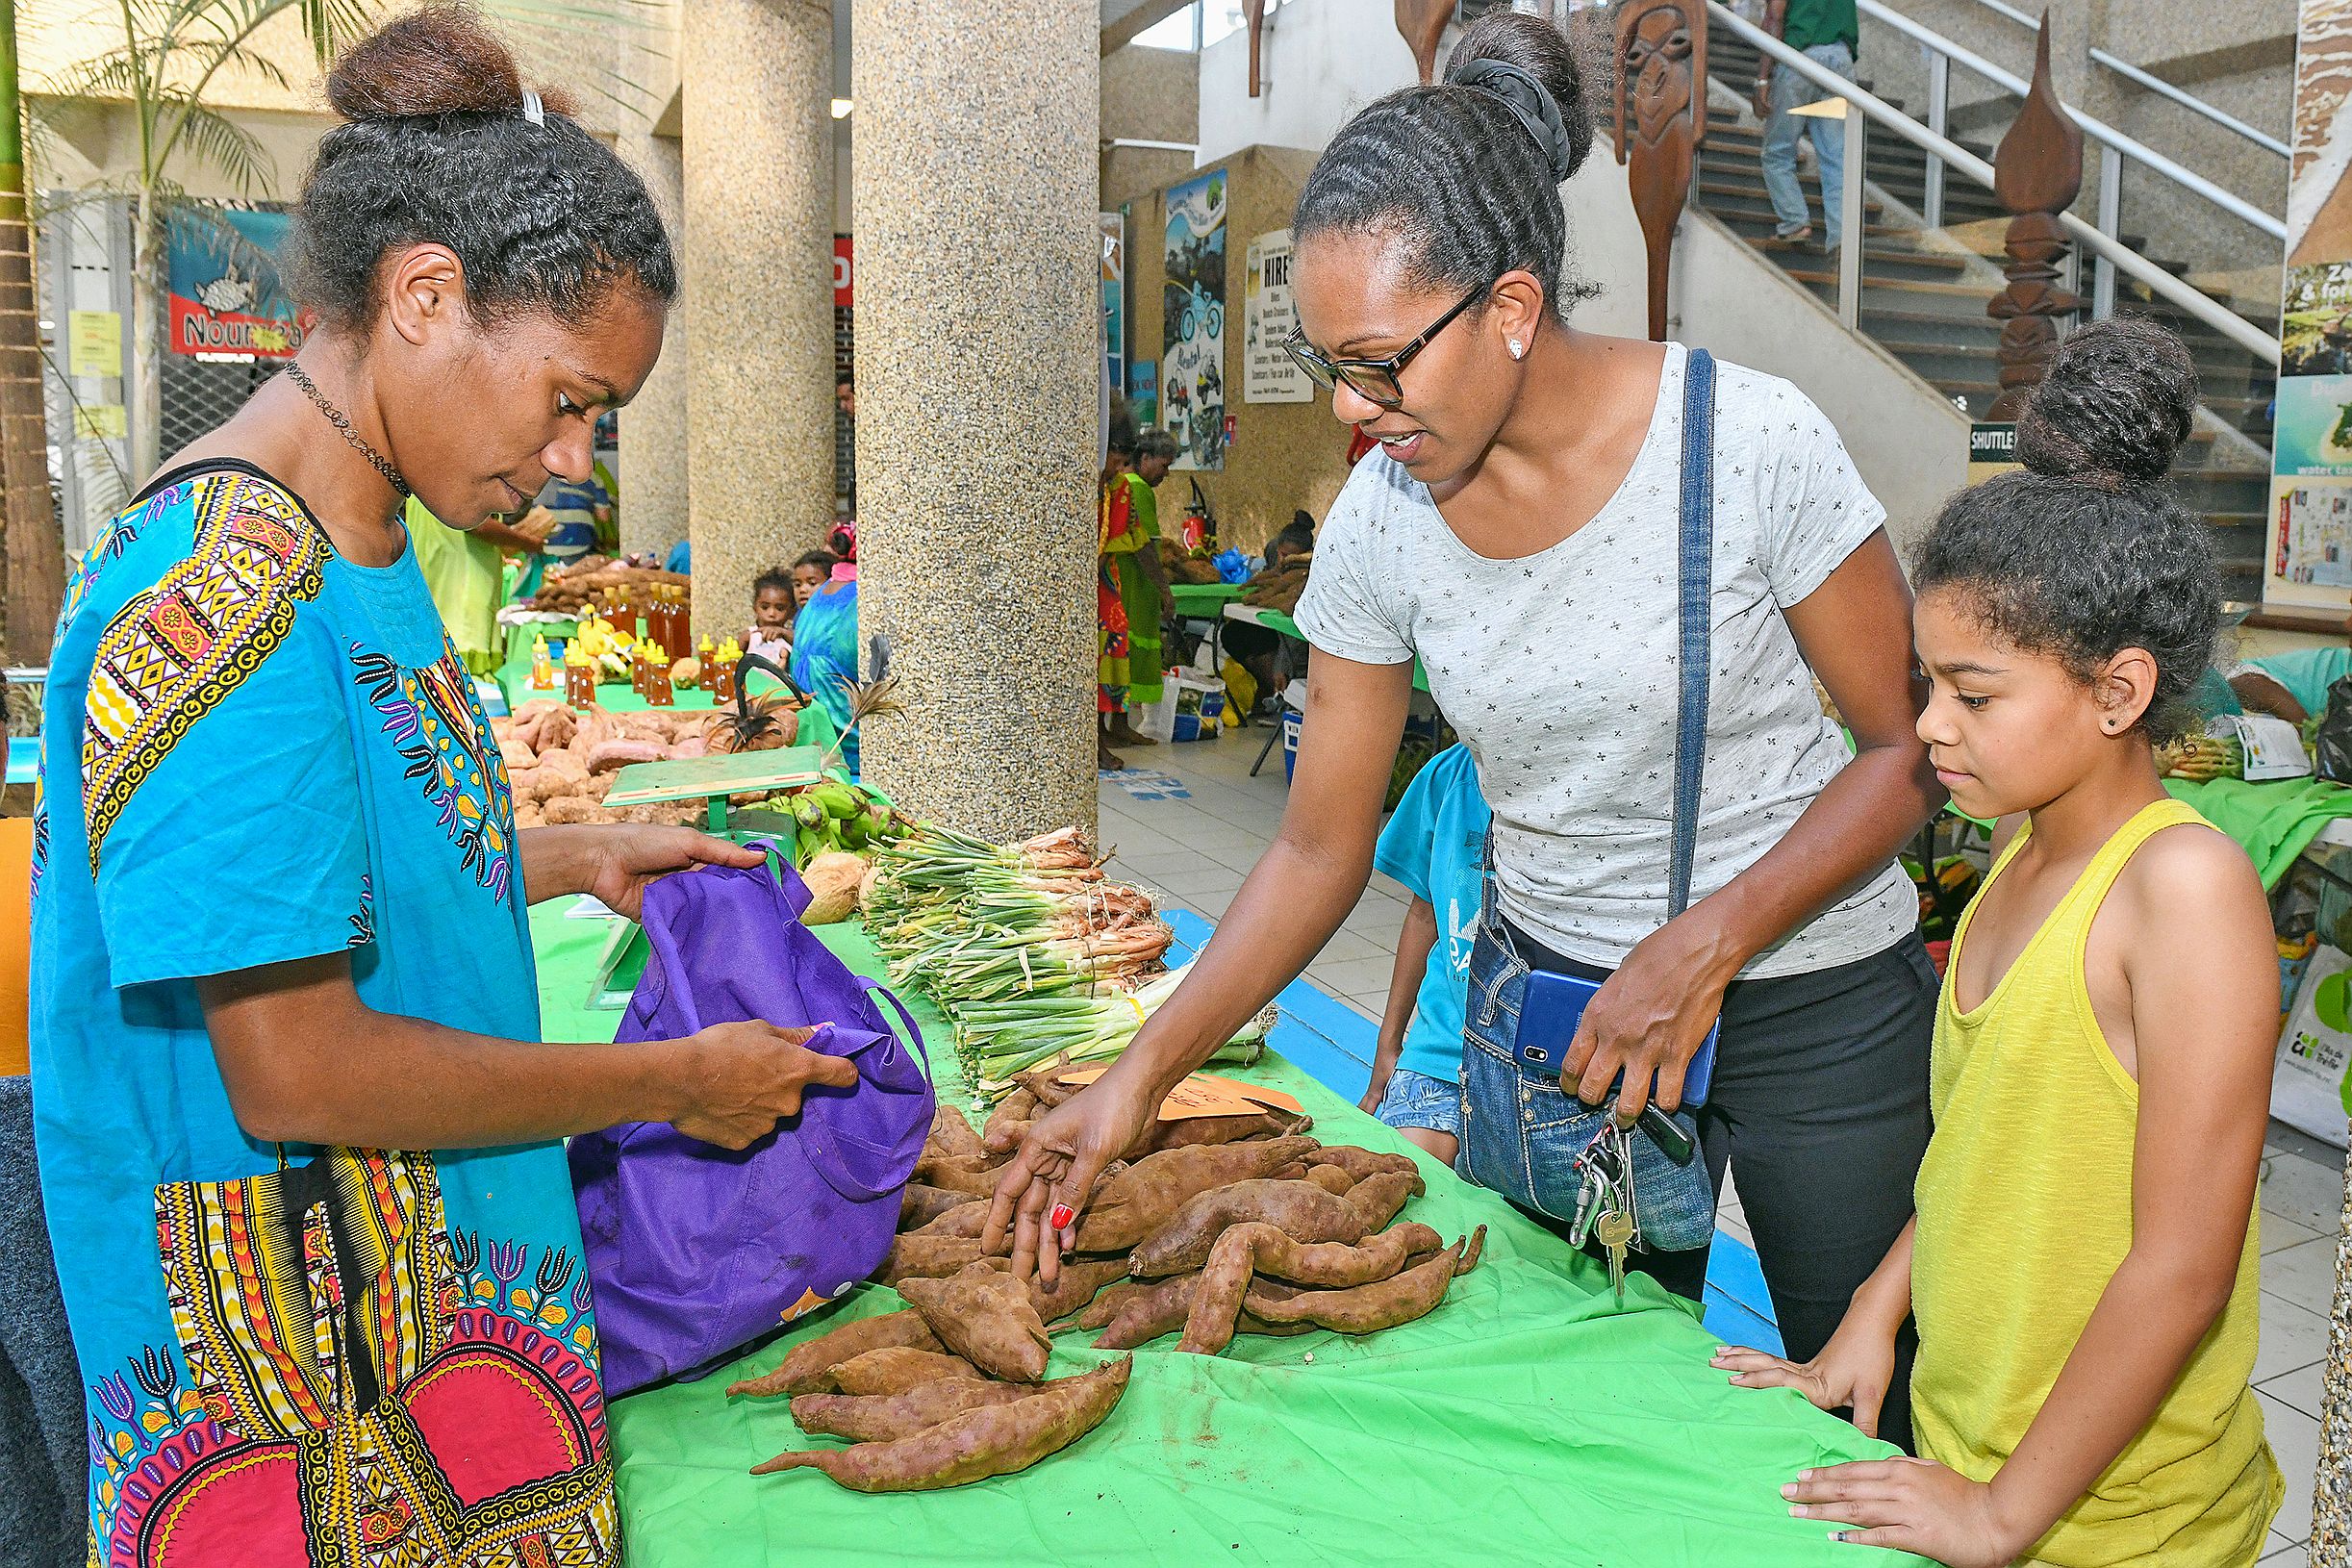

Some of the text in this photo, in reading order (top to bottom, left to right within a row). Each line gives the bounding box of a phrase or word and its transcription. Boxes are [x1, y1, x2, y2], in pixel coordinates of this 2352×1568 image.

[1264, 255, 1288, 288] HIRE
[2300, 283, 2315, 301] &
[1971, 431, 2013, 449] SHUTTLE
